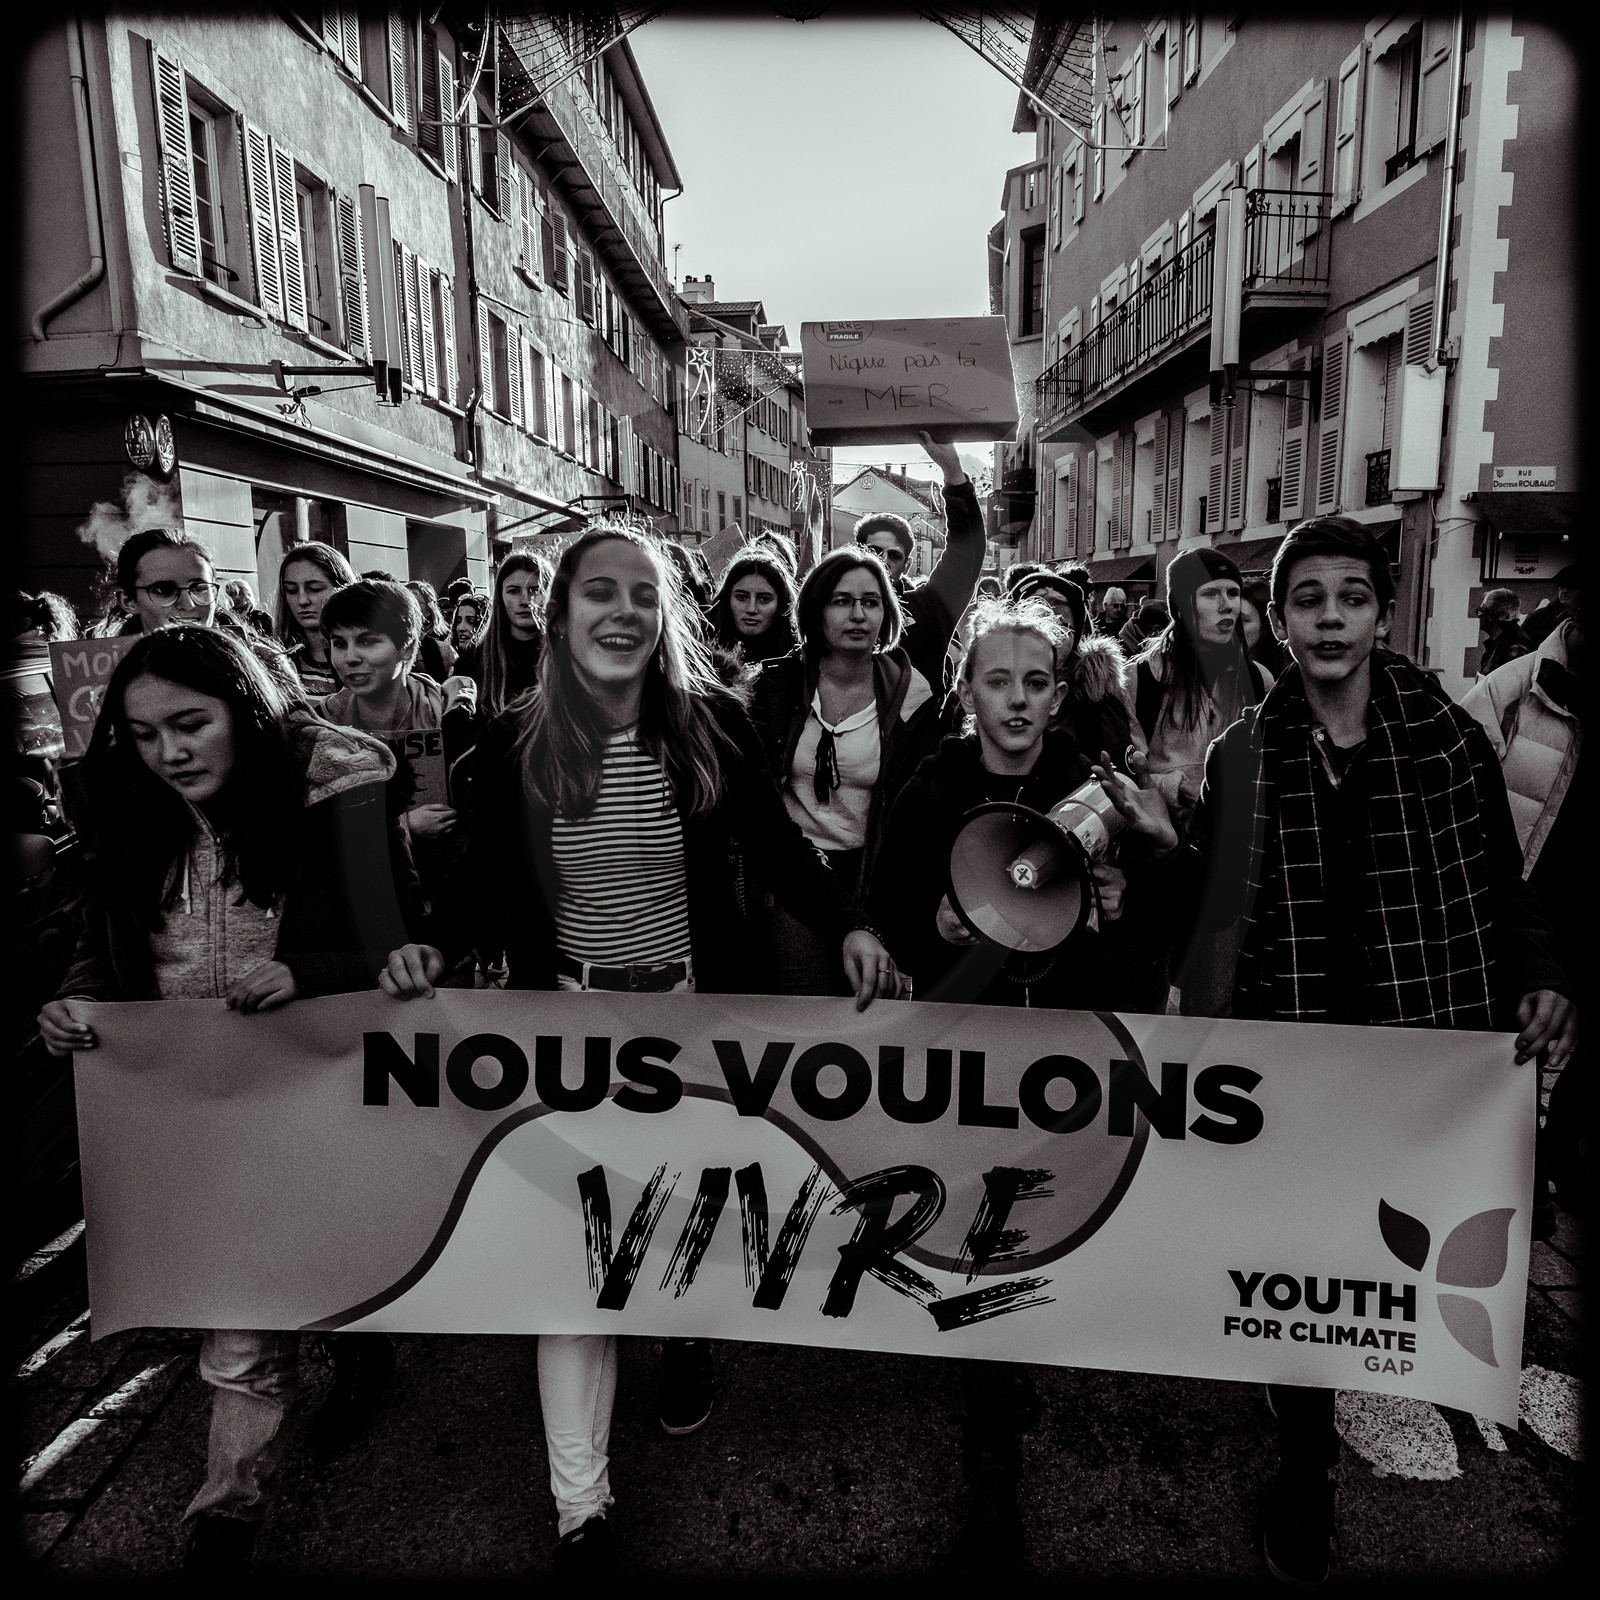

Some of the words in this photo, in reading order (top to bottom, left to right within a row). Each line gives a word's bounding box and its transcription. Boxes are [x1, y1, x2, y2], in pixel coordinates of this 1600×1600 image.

[829, 352, 888, 376] Nique
[903, 353, 941, 373] pas
[956, 351, 976, 367] ta
[864, 382, 953, 412] MER
[1518, 480, 1555, 488] ROUBAUD
[362, 1031, 684, 1113] NOUS
[711, 1039, 1265, 1145] VOULONS
[576, 1161, 1057, 1332] VIVRE
[1227, 1269, 1417, 1323] YOUTH
[1223, 1315, 1283, 1340] FOR
[1289, 1321, 1417, 1354] CLIMATE
[1363, 1355, 1415, 1377] GAP
